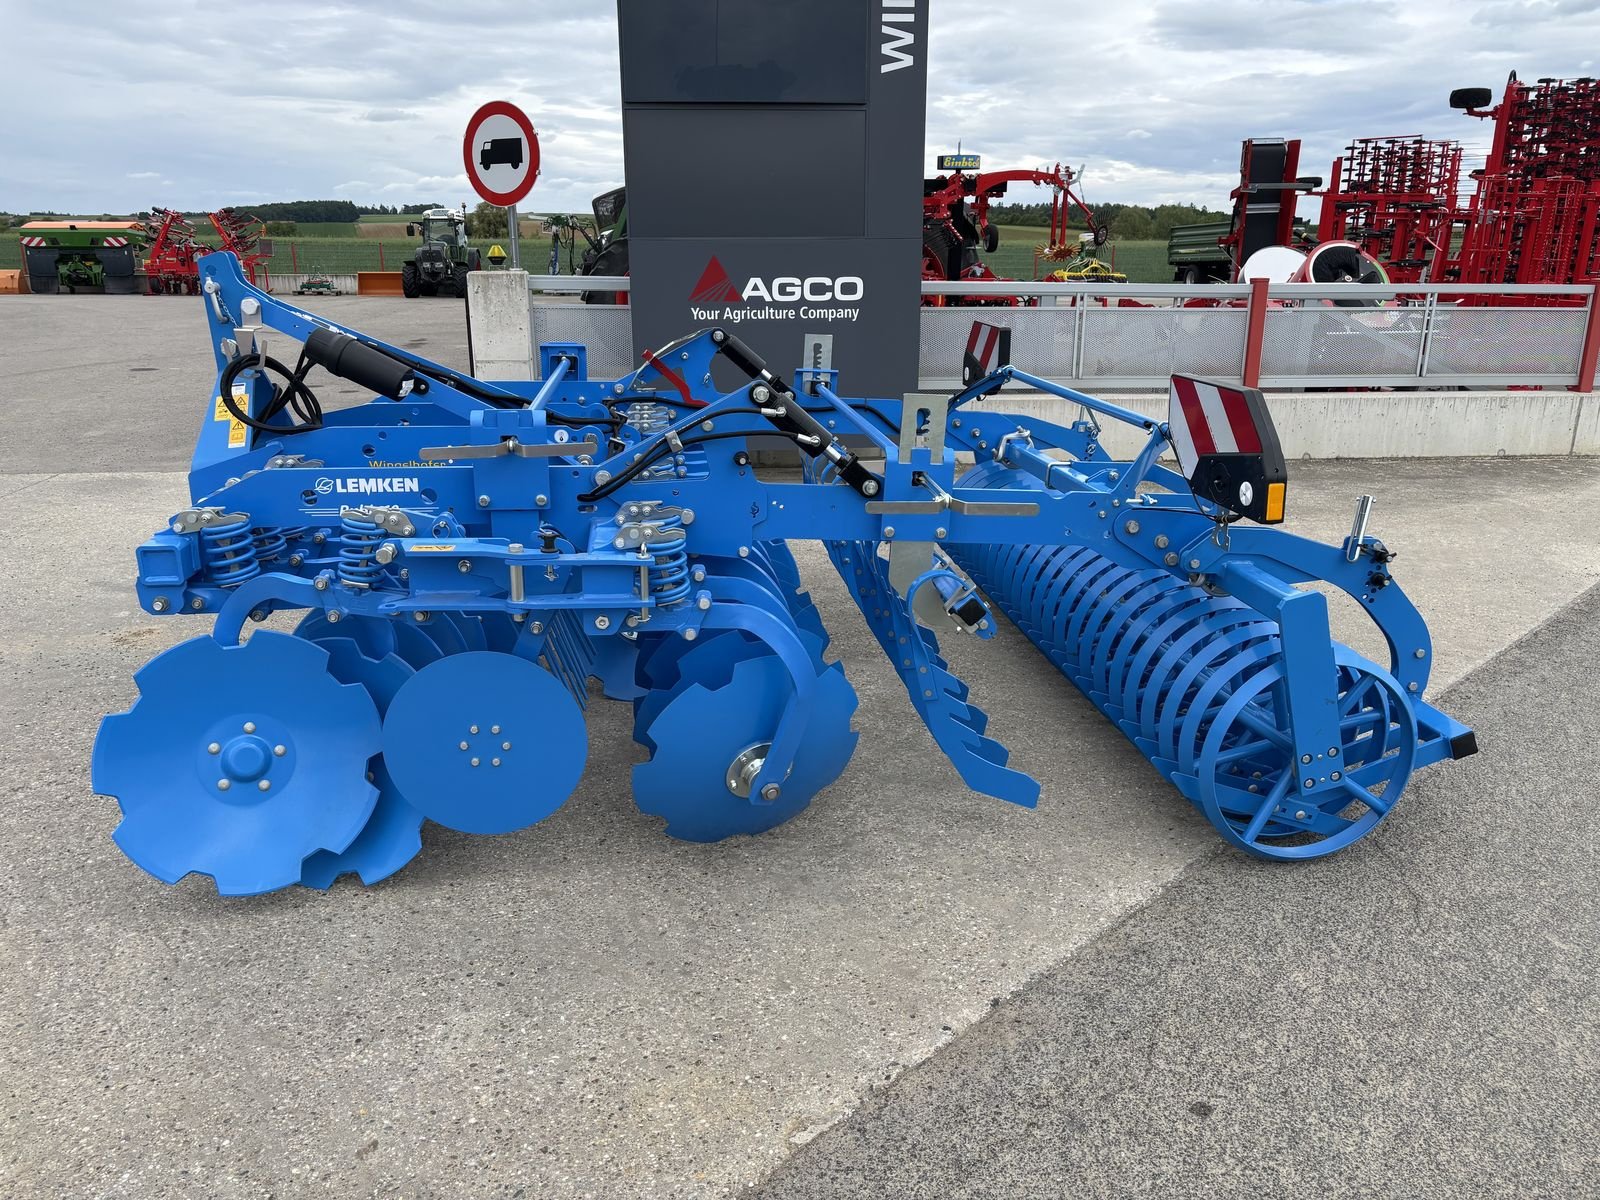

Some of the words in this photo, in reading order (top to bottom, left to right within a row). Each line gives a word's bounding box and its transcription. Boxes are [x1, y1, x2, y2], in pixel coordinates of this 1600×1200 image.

[880, 0, 915, 73] WI
[741, 276, 864, 302] AGCO
[691, 307, 720, 320] Your
[723, 306, 796, 323] Agriculture
[800, 306, 860, 322] Company
[335, 477, 419, 496] LEMKEN
